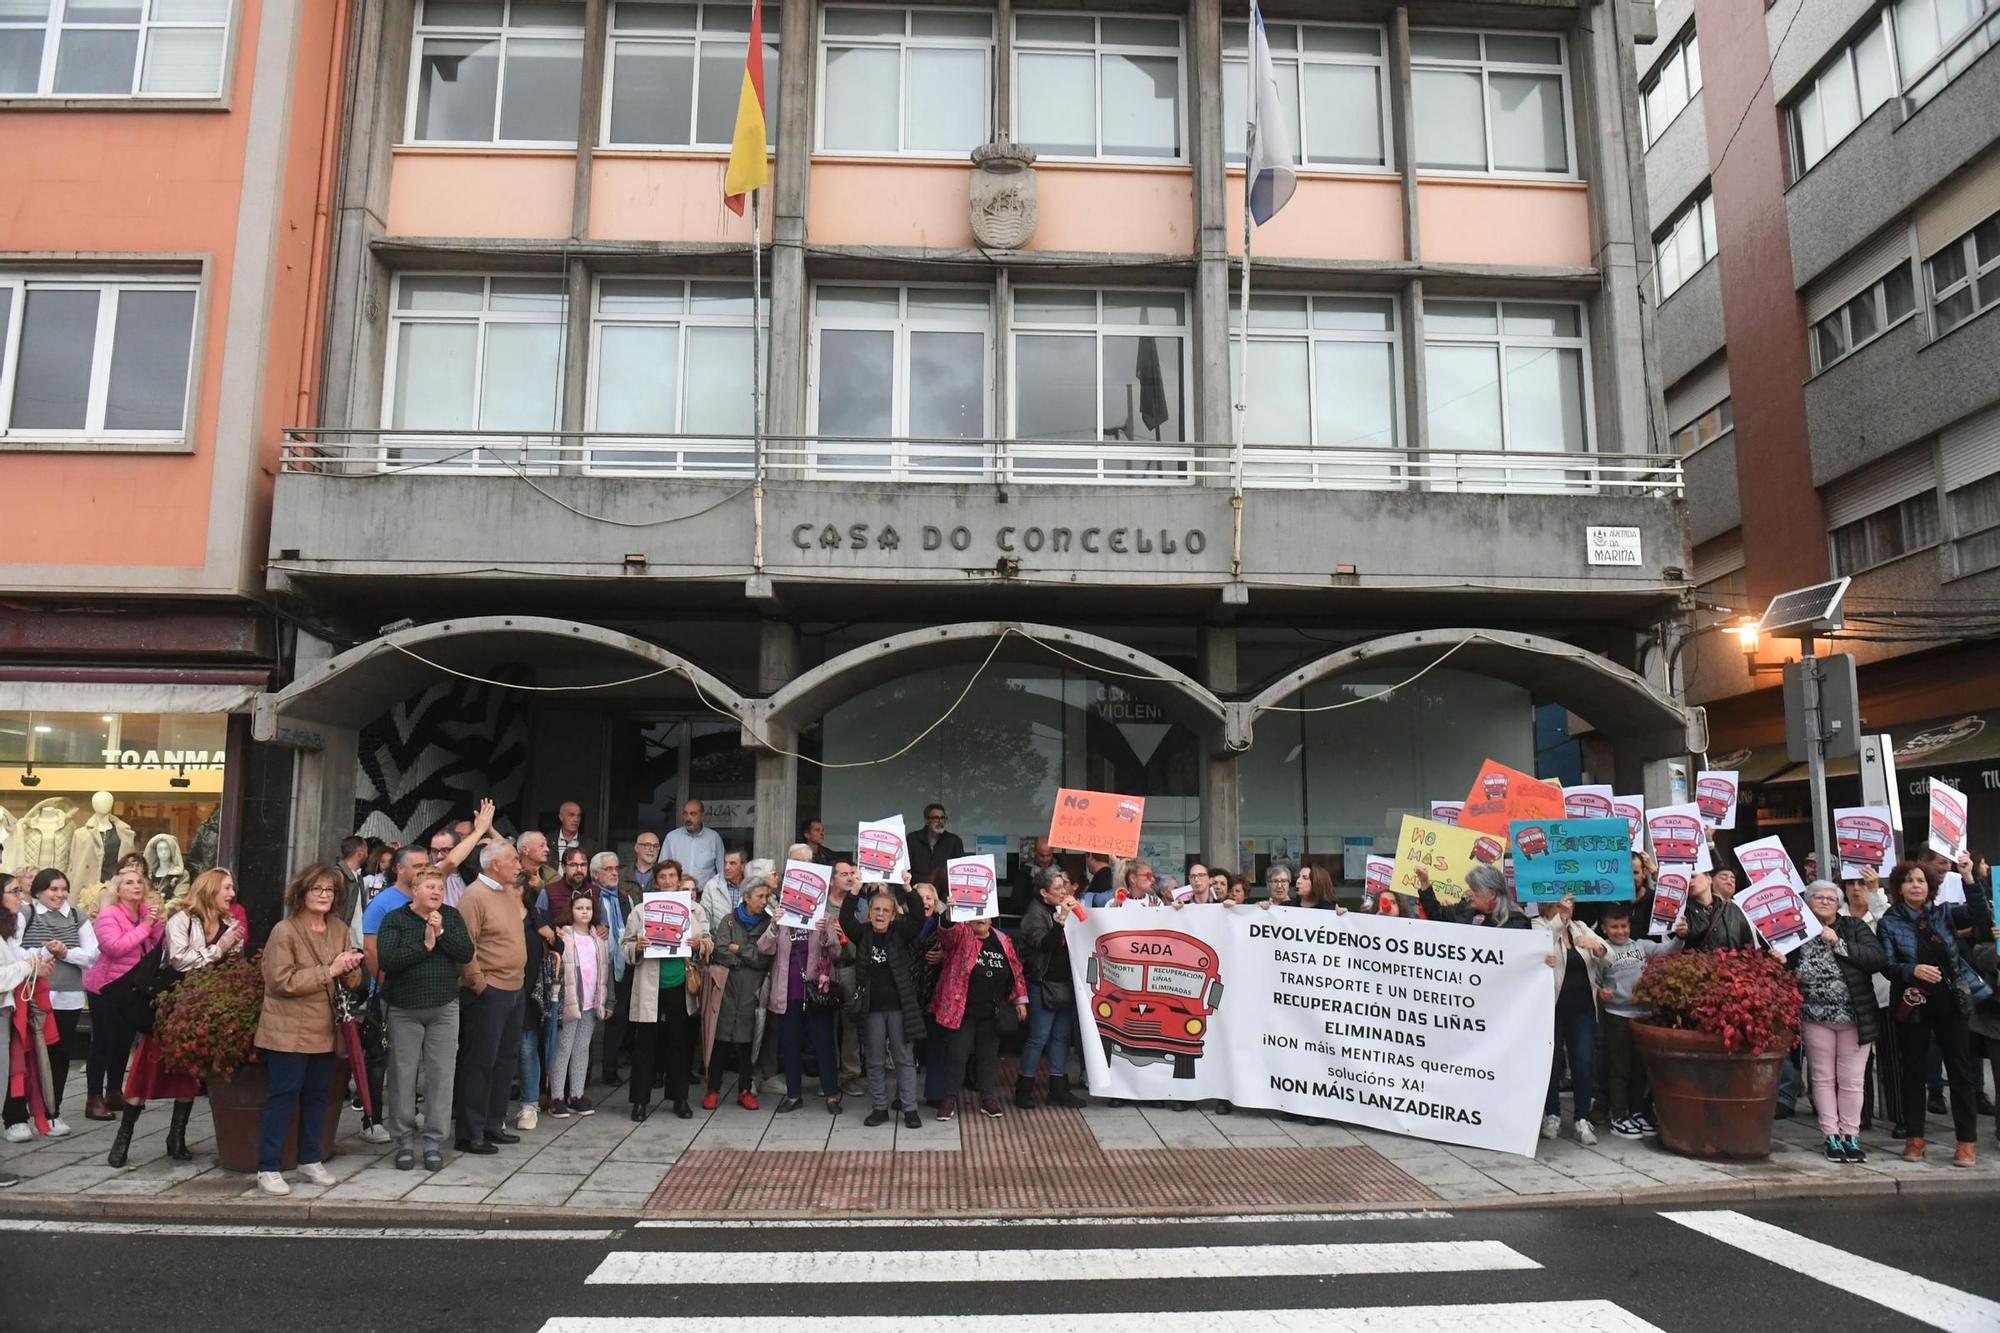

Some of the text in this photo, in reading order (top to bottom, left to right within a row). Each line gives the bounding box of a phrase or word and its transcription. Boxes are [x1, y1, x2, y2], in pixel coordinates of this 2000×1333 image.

[792, 523, 900, 549] CASA
[922, 525, 972, 551] DO
[1063, 795, 1090, 810] NO
[1411, 827, 1436, 846] NO
[1407, 848, 1448, 872] MÁS
[1130, 942, 1173, 956] SADA
[1249, 924, 1504, 965] DEVOLVÉDENOS OS BUSES XA!
[1153, 968, 1203, 980] RECUPERACIÓN
[1274, 949, 1481, 986] BASTA DE INCOMPETENCIA! O
[1151, 984, 1192, 996] ELIMINADAS
[1280, 971, 1475, 1008] TRANSPORTE E UN DEREITO
[1273, 992, 1486, 1032] RECUPERACIÓN DAS LIÑAS
[1325, 1021, 1426, 1047] ELIMINADAS
[1304, 1041, 1336, 1056] máis
[1341, 1046, 1415, 1068] MENTIRAS
[1421, 1059, 1495, 1081] queremos
[1327, 1067, 1425, 1093] solucións XA!
[1270, 1075, 1482, 1126] NON MÁIS LANZADEIRAS
